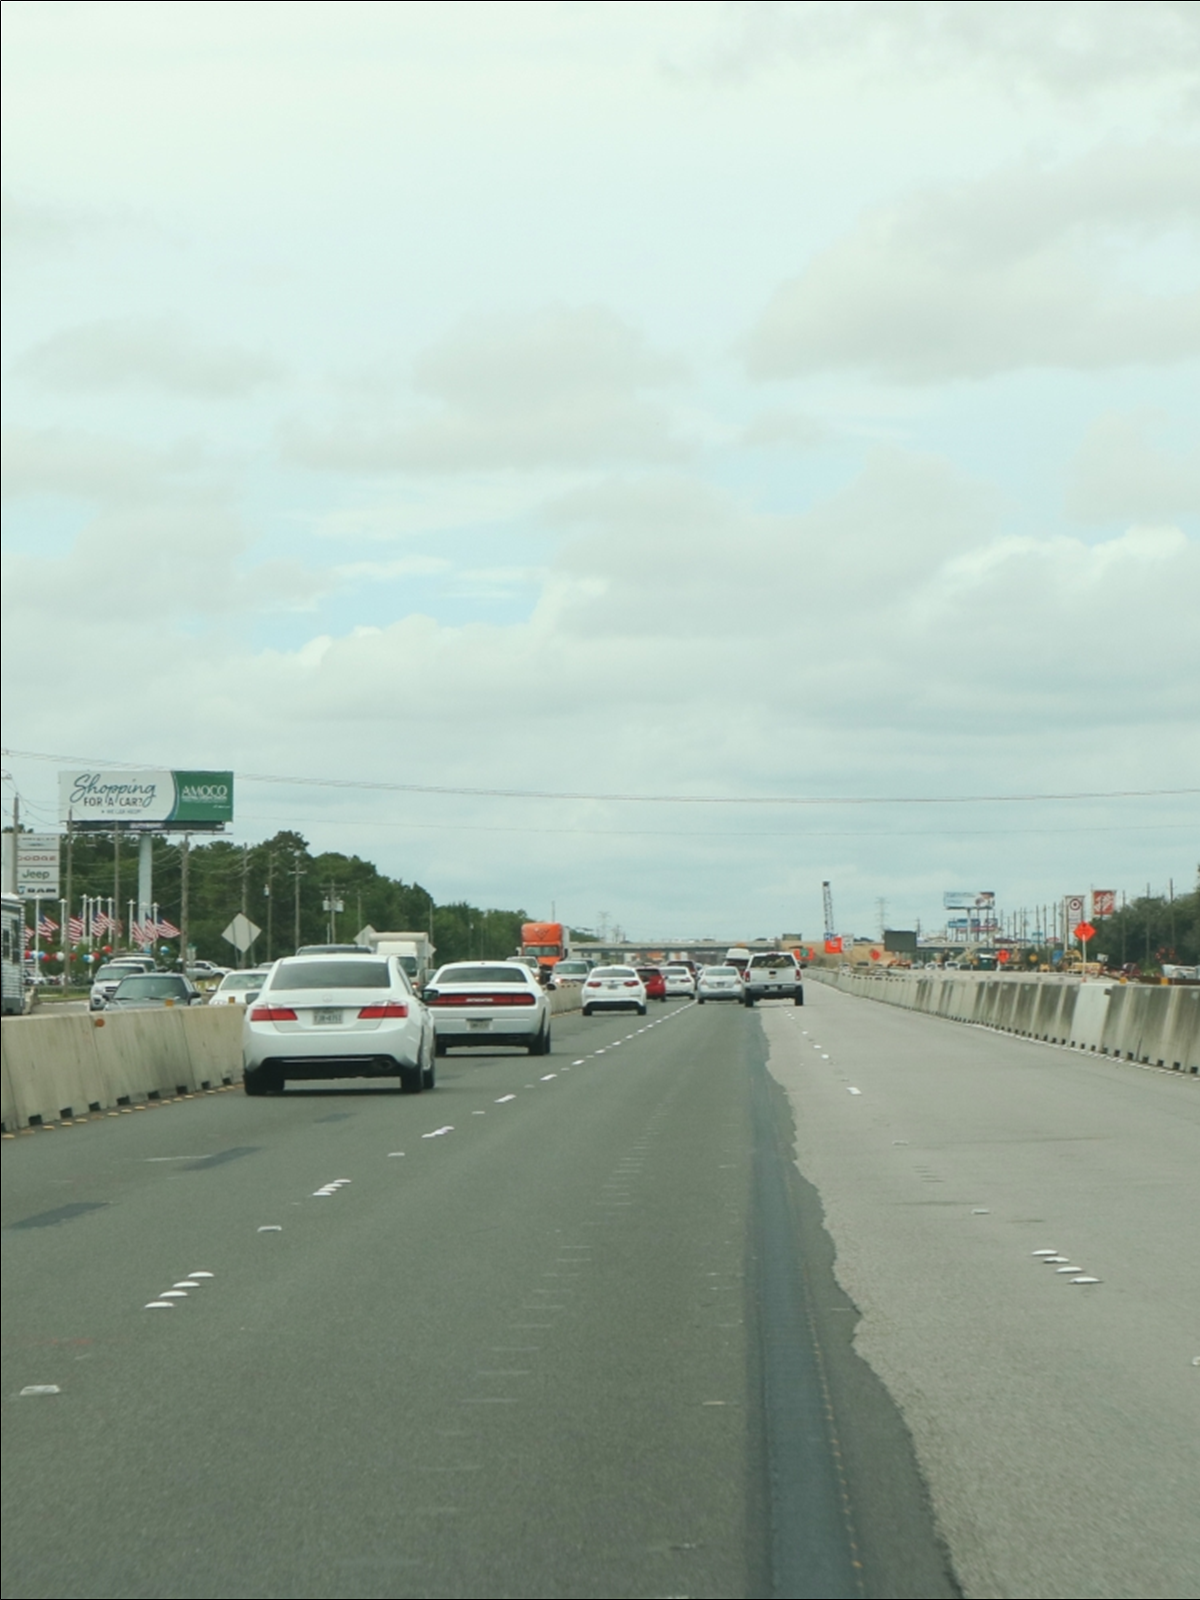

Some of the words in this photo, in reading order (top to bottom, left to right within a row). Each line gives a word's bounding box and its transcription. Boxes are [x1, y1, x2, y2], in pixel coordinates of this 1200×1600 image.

[69, 774, 157, 808] Shopping
[182, 785, 228, 797] AMOCO
[84, 797, 102, 807] FOR
[106, 797, 114, 807] A
[119, 797, 143, 807] CAR?
[22, 869, 50, 880] Jeep
